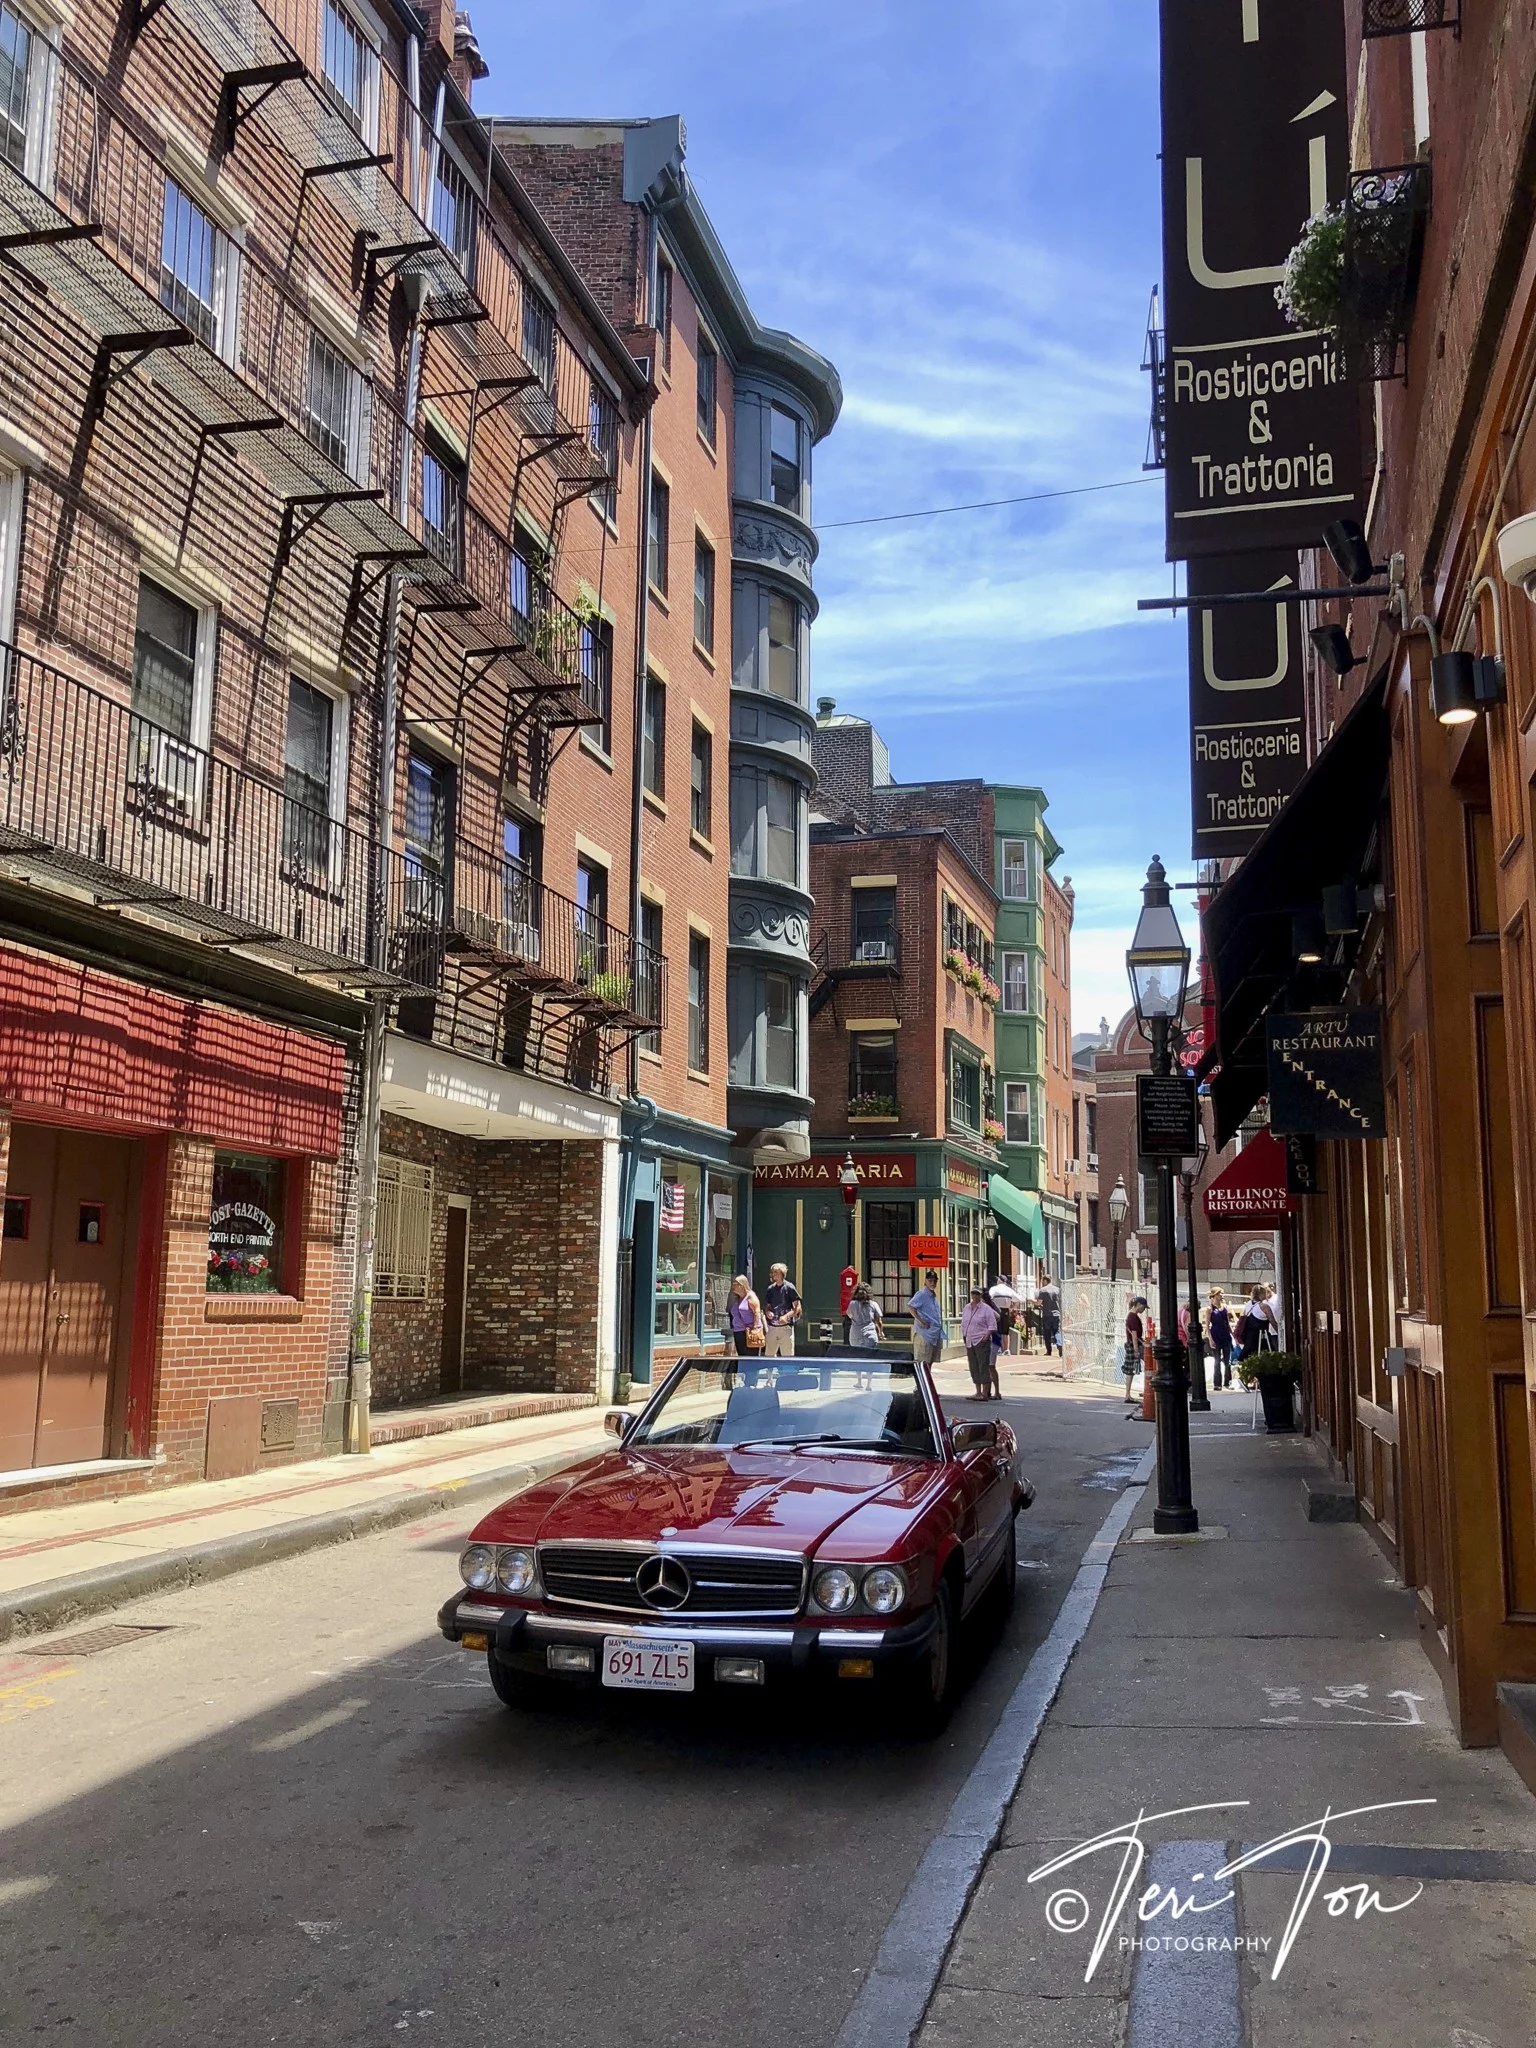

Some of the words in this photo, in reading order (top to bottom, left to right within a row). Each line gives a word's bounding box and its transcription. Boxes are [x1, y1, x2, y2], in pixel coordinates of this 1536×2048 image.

[1248, 399, 1273, 444] &
[1191, 442, 1334, 498] Trattoria
[1195, 727, 1300, 761] Rosticceria
[1241, 760, 1256, 788] &
[1272, 1035, 1376, 1051] RESTAURANT
[1282, 1052, 1371, 1128] ENTRANCE
[1288, 1134, 1304, 1160] AKE
[754, 1164, 830, 1178] MAMMA
[1296, 1164, 1313, 1187] OUT
[1208, 1187, 1287, 1200] PELLINO'S
[1208, 1200, 1287, 1211] RISTORANTE
[209, 1202, 276, 1236] OST-GAZETTE
[230, 1233, 244, 1244] END
[245, 1234, 273, 1247] PRINTING
[912, 1239, 945, 1249] DETOUR
[626, 1639, 674, 1652] Massachusetts
[609, 1651, 645, 1677] 691
[651, 1653, 689, 1679] ZL5
